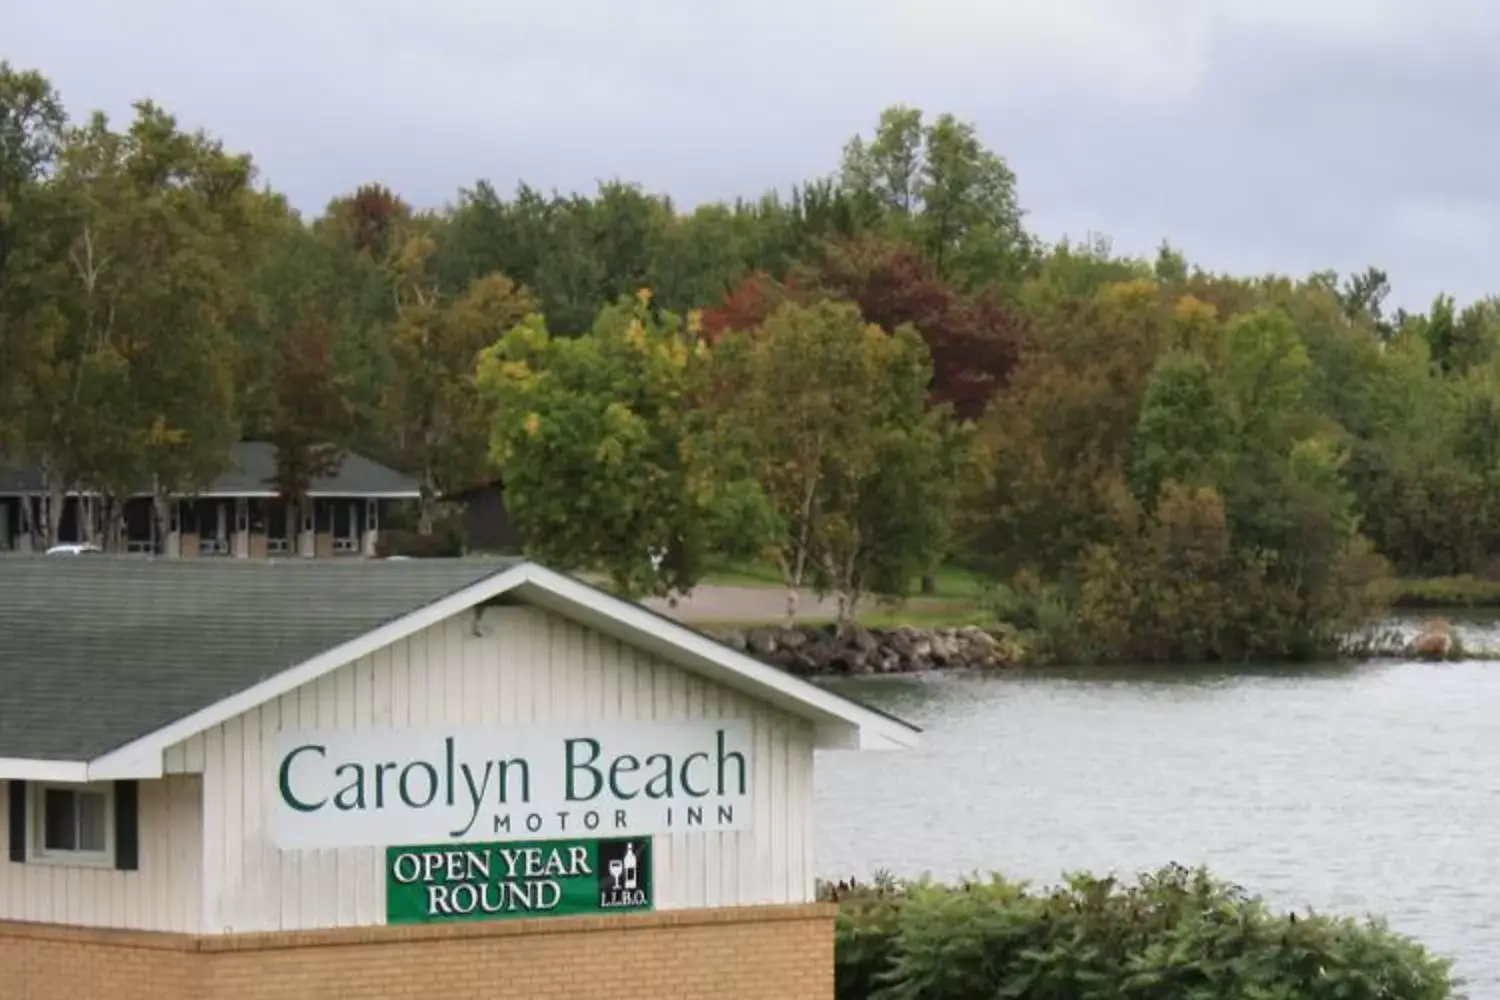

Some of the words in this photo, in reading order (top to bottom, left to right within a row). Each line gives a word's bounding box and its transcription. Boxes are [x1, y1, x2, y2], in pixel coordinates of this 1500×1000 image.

[278, 737, 531, 837] Carolyn
[563, 730, 747, 802] Beach
[493, 810, 629, 833] MOTOR
[667, 805, 734, 826] INN
[393, 847, 492, 884] OPEN
[498, 845, 593, 878] YEAR
[427, 880, 562, 916] ROUND
